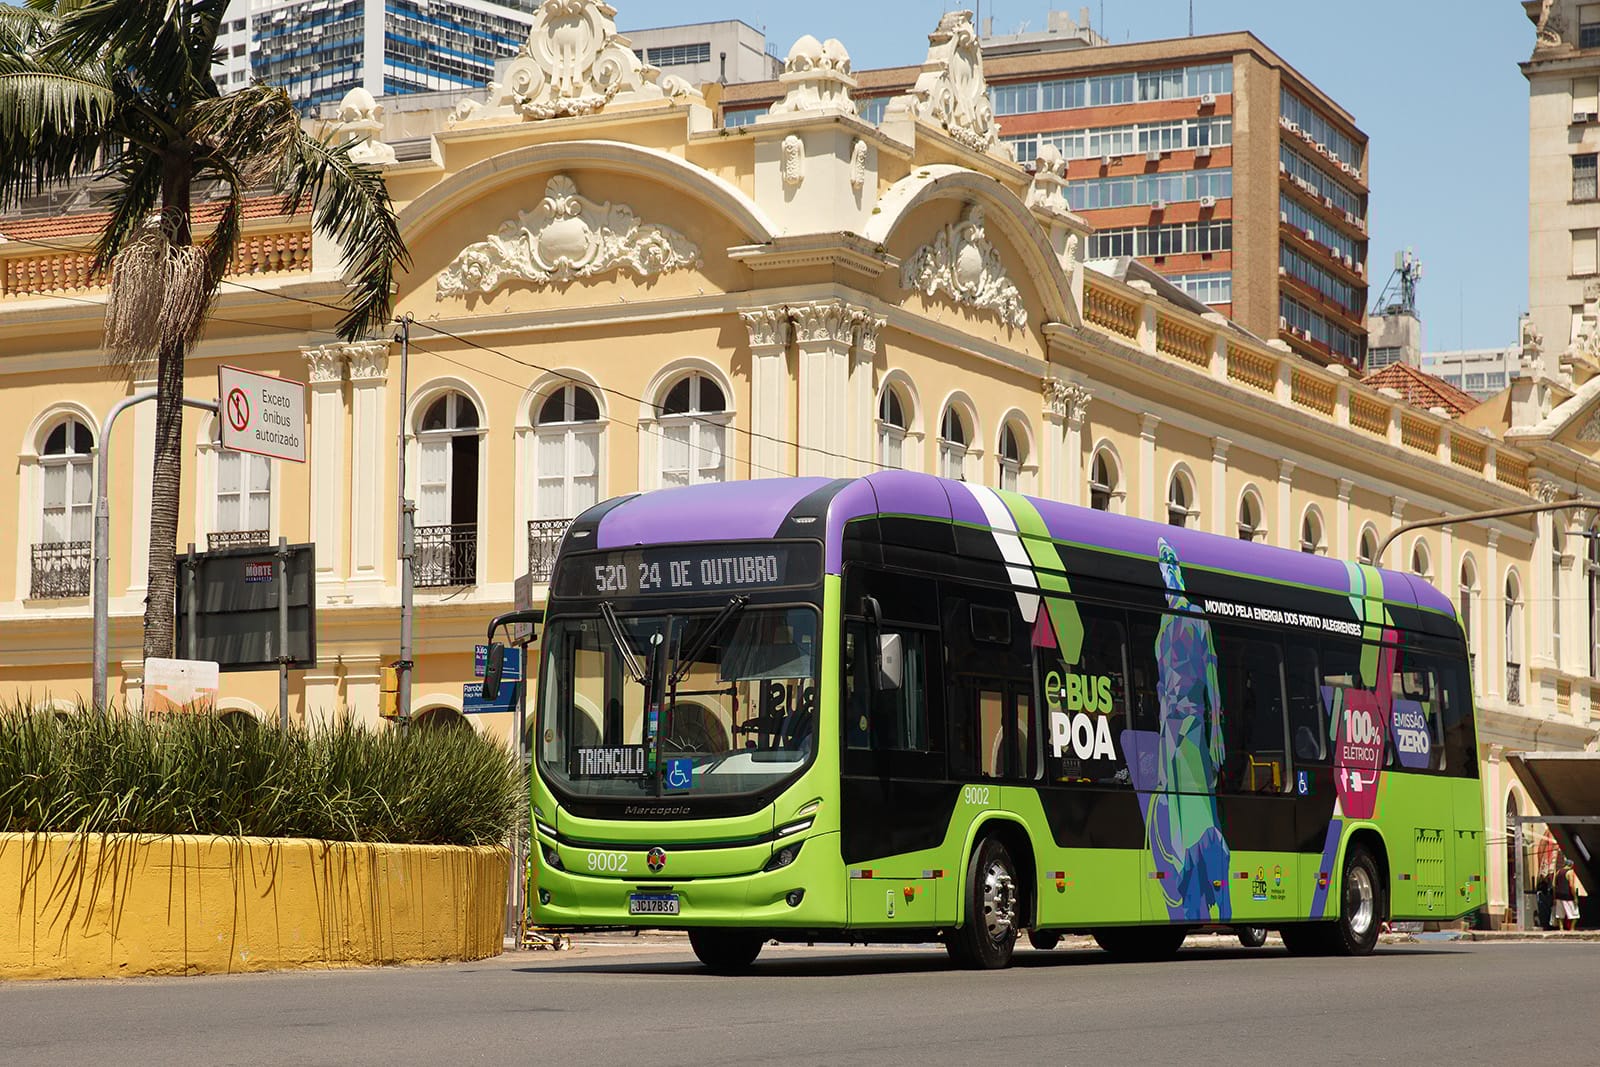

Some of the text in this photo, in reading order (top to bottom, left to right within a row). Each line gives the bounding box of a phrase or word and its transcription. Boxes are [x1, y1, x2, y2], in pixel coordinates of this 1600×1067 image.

[262, 389, 290, 408] Exceto
[263, 409, 291, 427] ônibus
[255, 429, 299, 447] autorizado
[594, 555, 778, 591] 520 24 DE OUTUBRO
[1204, 600, 1361, 636] MOVIDO PELA ENERGIA DOS PORTO ALEGRENSES
[1045, 671, 1113, 713] e-BUS
[1344, 710, 1380, 745] 100%
[1393, 711, 1424, 729] EMISSÃO
[1051, 712, 1117, 760] POA
[1397, 729, 1429, 754] ZERO
[1343, 743, 1375, 761] ELÉTRICO
[965, 787, 989, 804] 9002
[625, 806, 691, 816] Marcopolo
[587, 852, 628, 871] 9002
